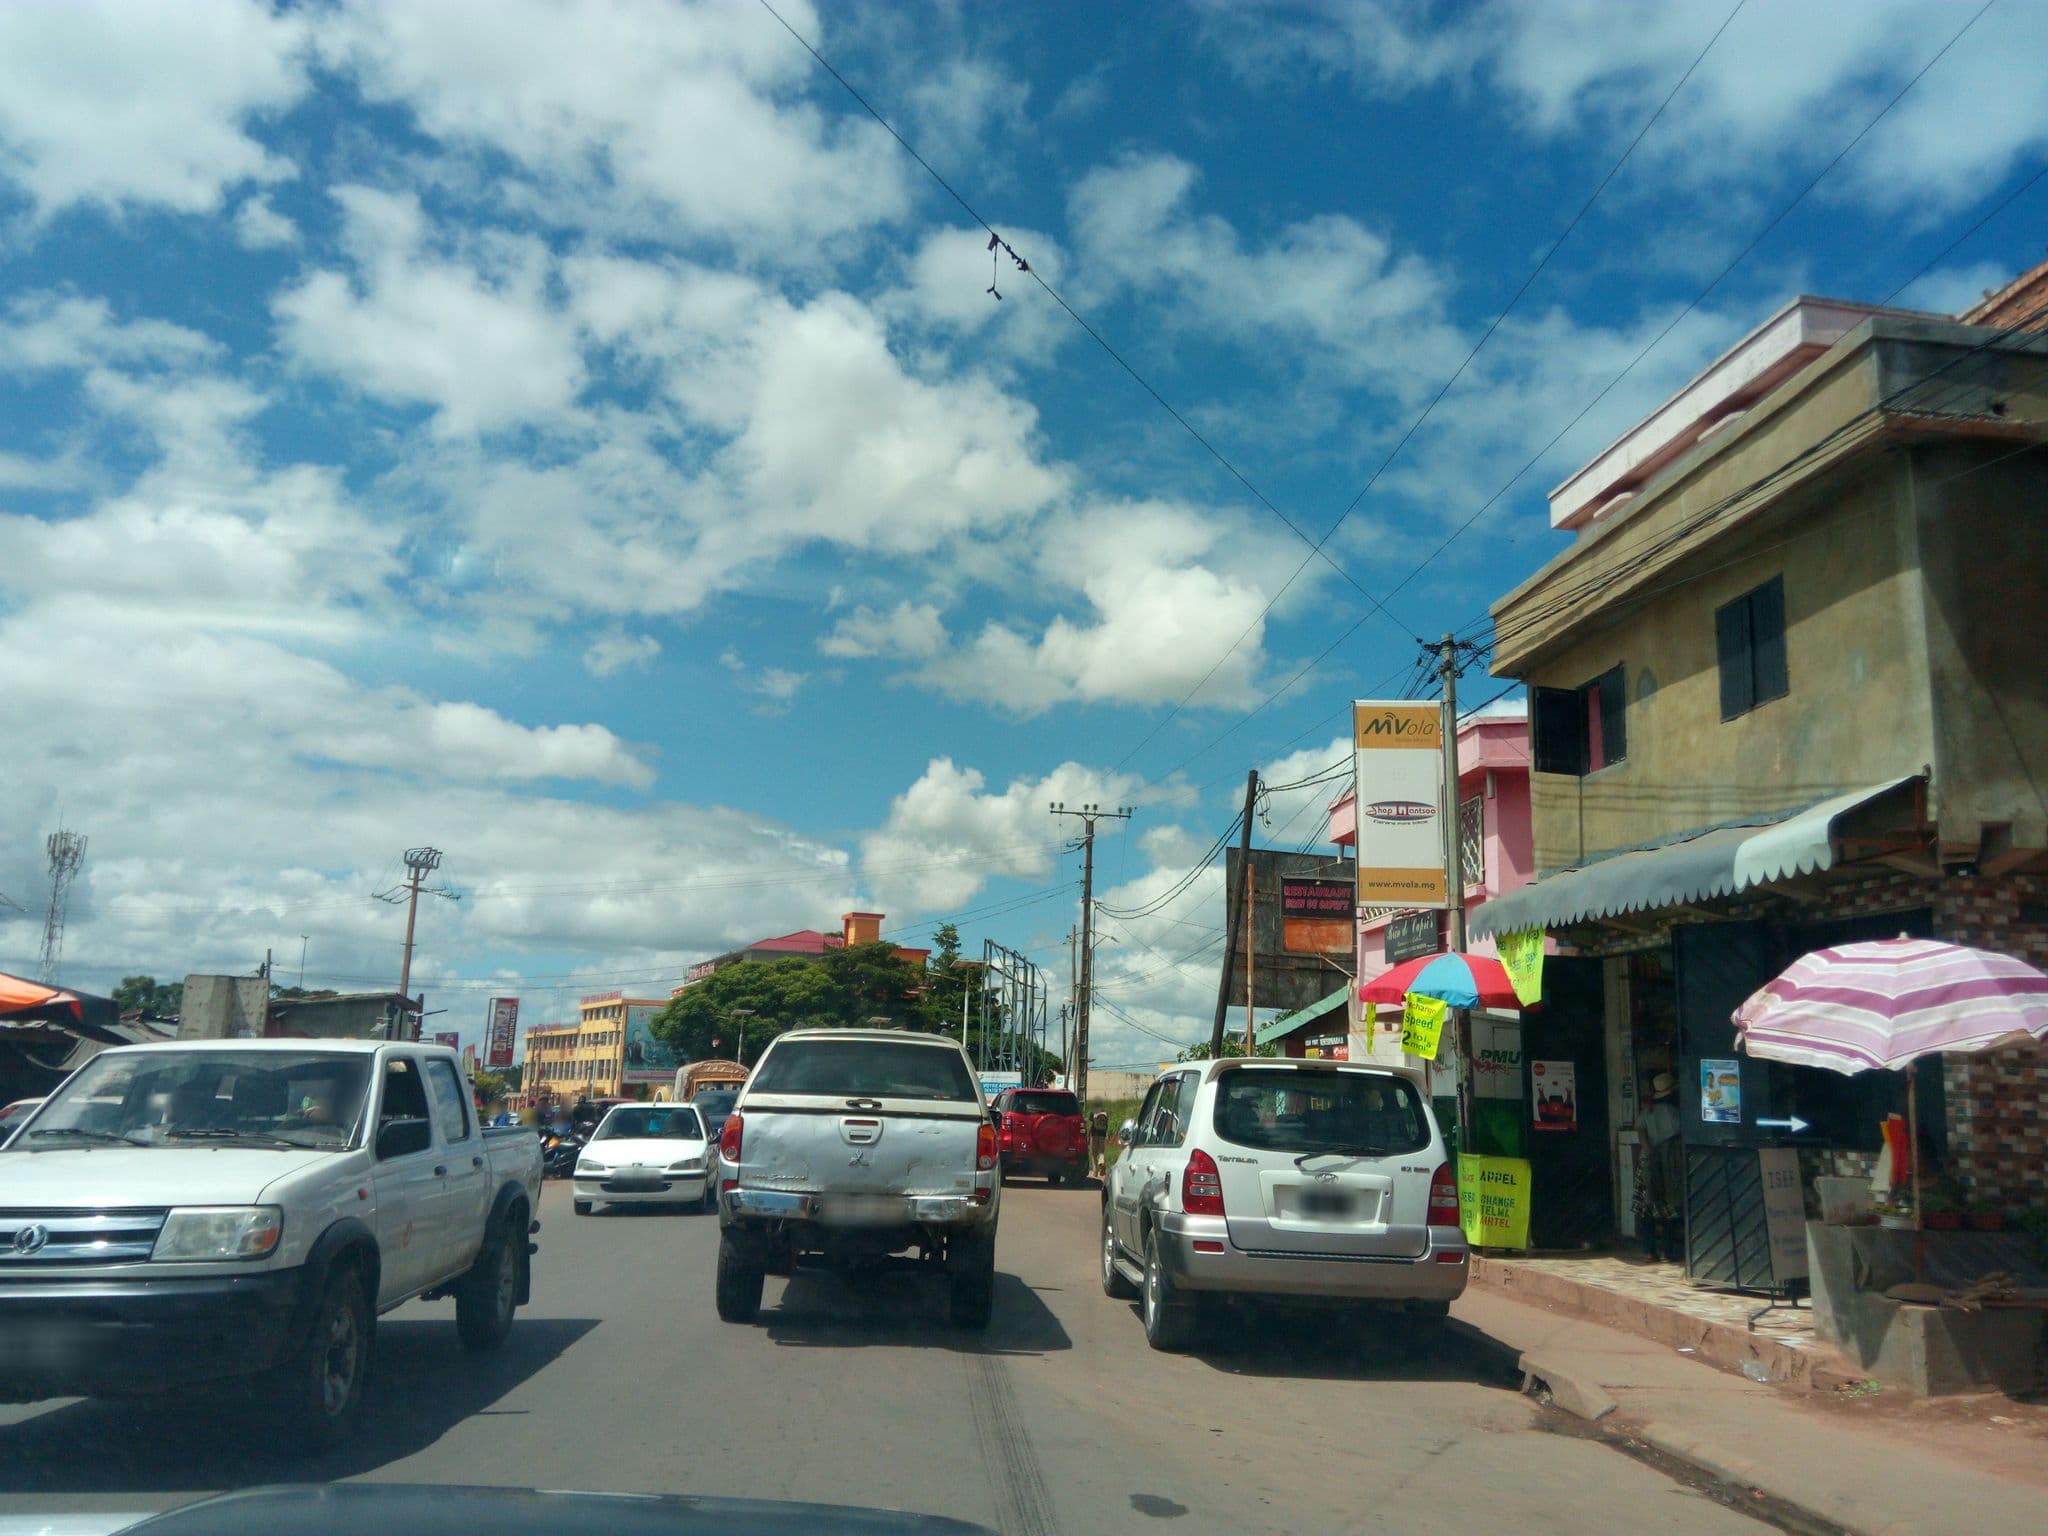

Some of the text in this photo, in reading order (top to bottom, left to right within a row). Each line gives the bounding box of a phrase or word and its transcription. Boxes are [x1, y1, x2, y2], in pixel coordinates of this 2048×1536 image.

[1364, 718, 1434, 735] MVola
[1365, 806, 1392, 817] Shop
[1368, 881, 1435, 890] www.mvola.mg
[1405, 1012, 1434, 1029] Speed
[1480, 1050, 1520, 1064] PMU
[1480, 1171, 1517, 1185] APPEL
[1481, 1205, 1510, 1217] TELMA
